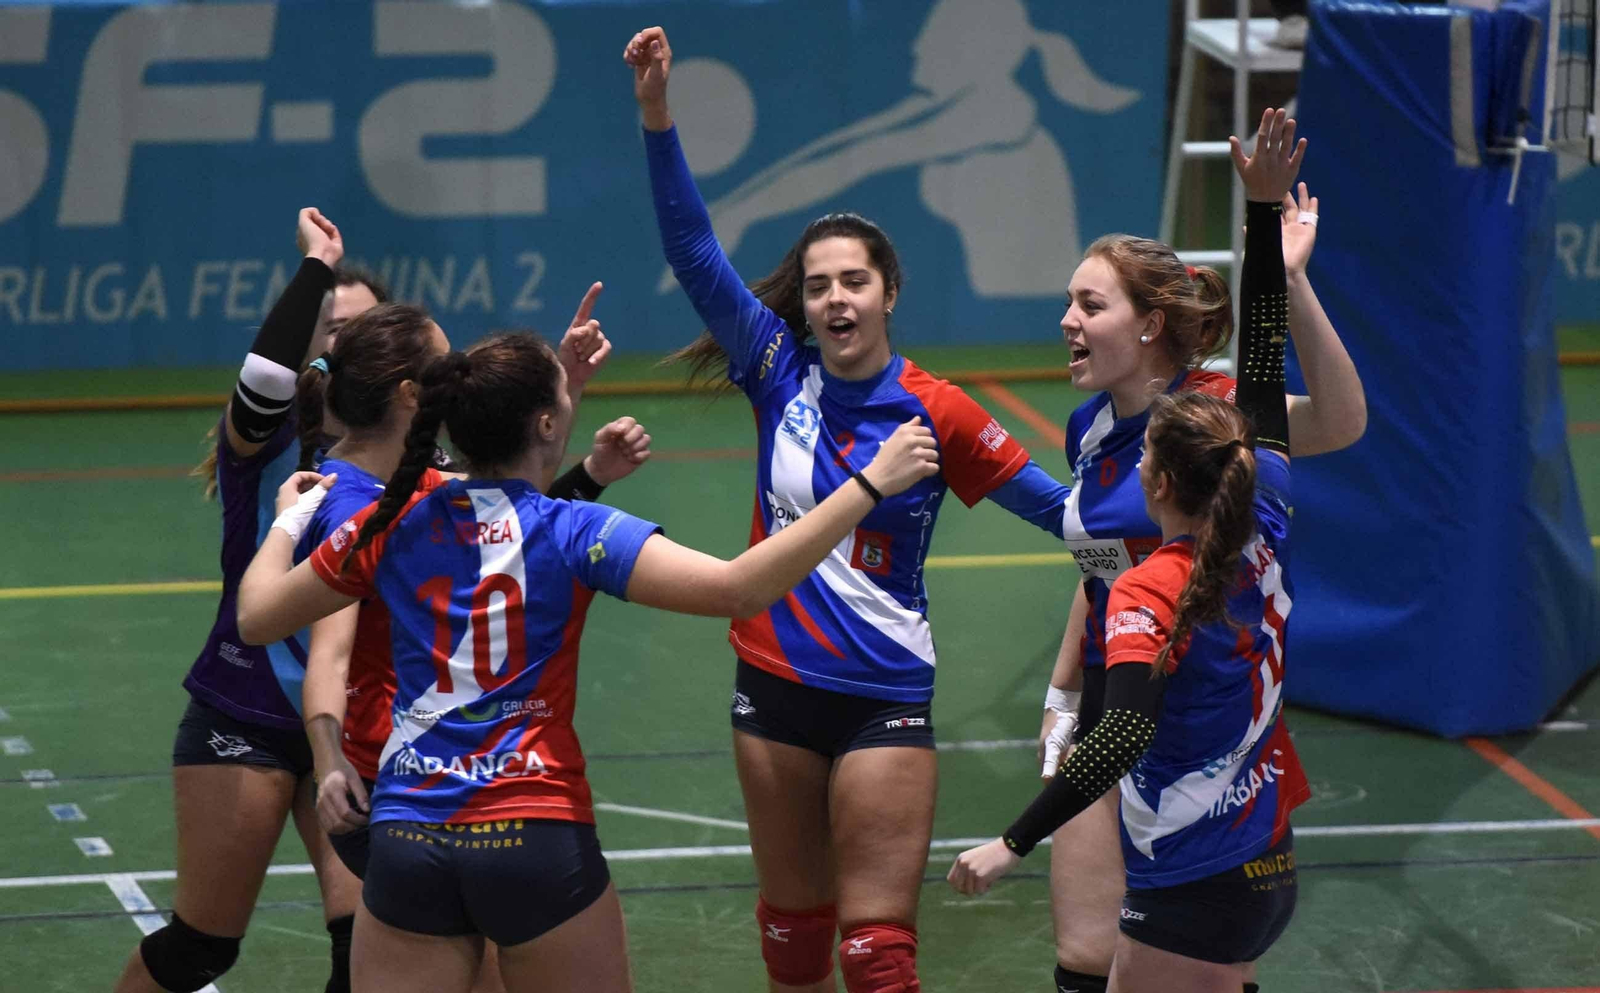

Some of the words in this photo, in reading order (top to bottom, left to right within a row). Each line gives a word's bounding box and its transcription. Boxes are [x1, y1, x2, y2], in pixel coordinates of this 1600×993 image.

[515, 252, 545, 311] 2
[834, 431, 855, 469] 2
[1087, 559, 1118, 570] VIGO
[417, 573, 527, 693] 10
[502, 699, 546, 711] GALICIA
[394, 749, 549, 781] ABANCA
[387, 828, 434, 844] CHAPA
[455, 837, 523, 849] PINTURA
